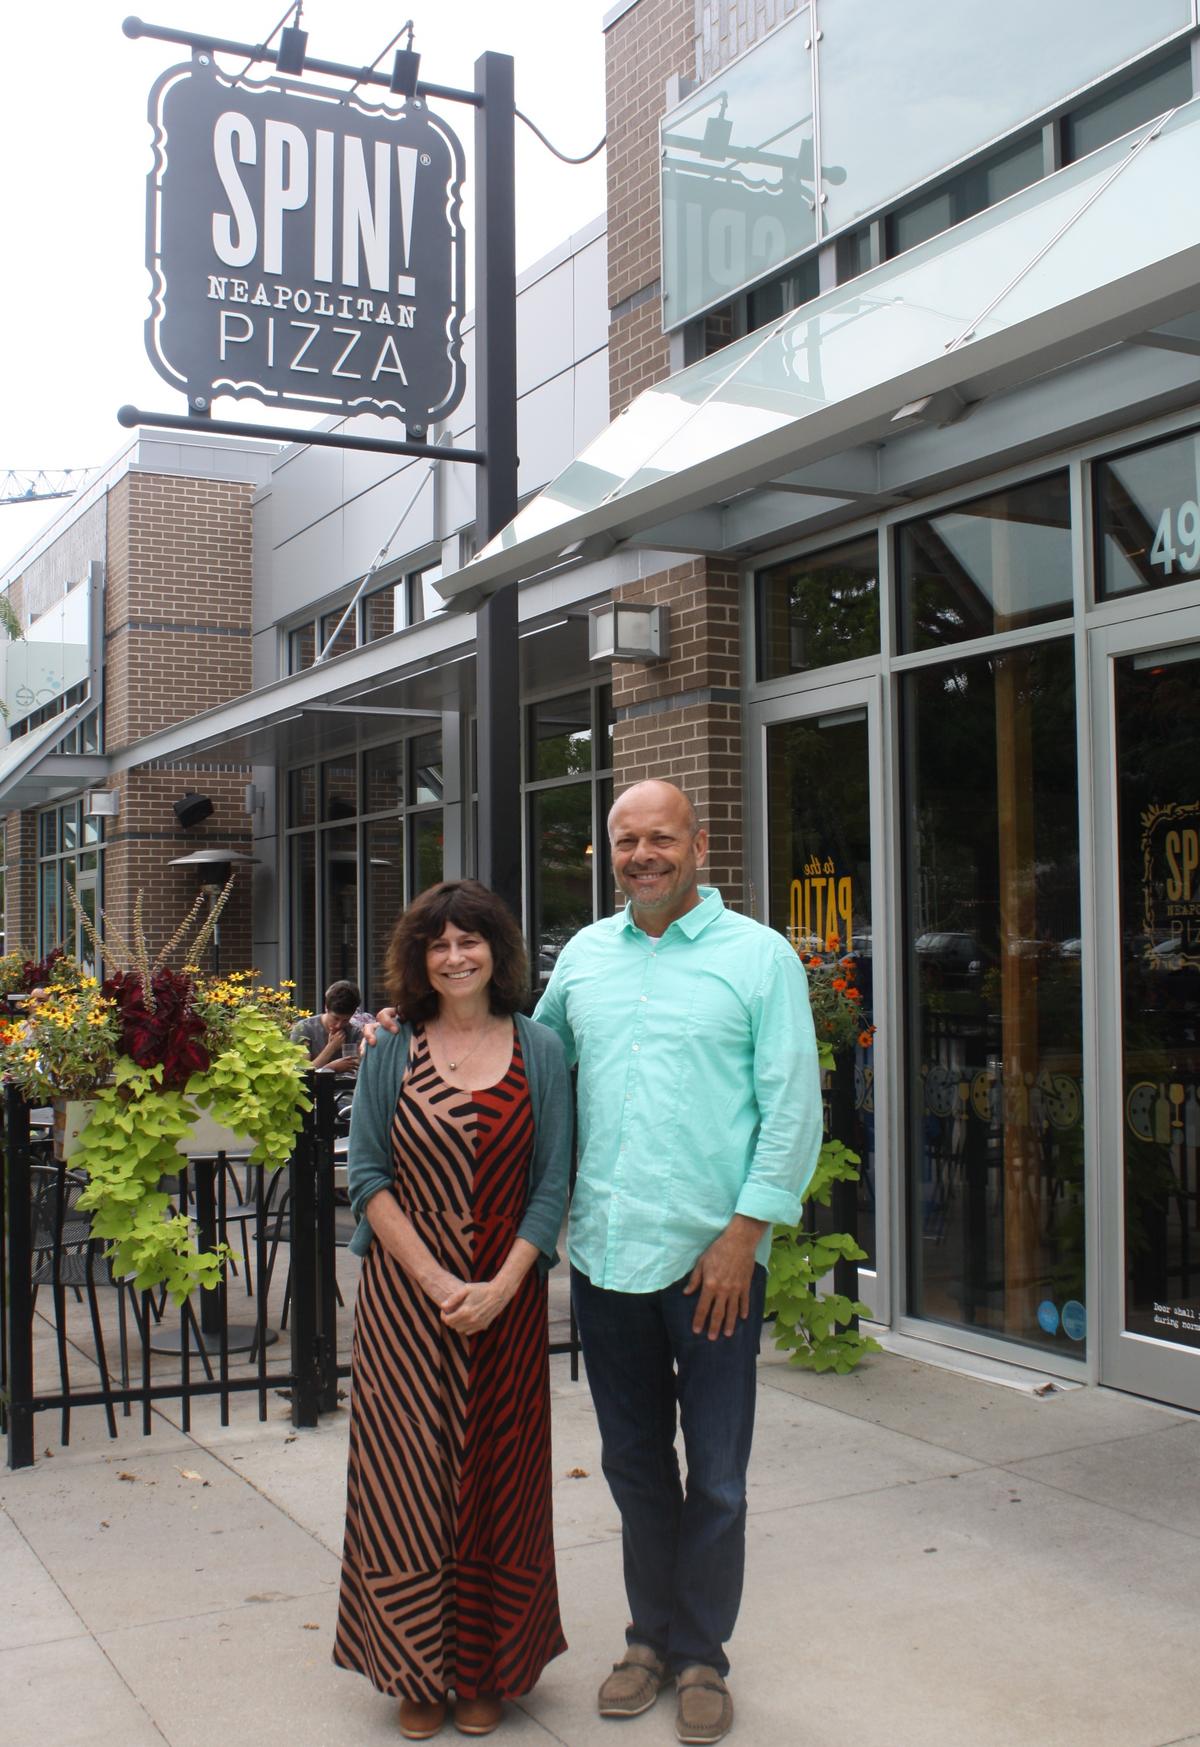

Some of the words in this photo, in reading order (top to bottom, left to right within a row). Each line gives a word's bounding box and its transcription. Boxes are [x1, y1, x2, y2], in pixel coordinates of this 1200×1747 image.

[207, 274, 417, 329] NEAPOLITAN
[219, 310, 409, 387] PIZZA
[1153, 1302, 1172, 1314] Door
[1153, 1314, 1179, 1329] during
